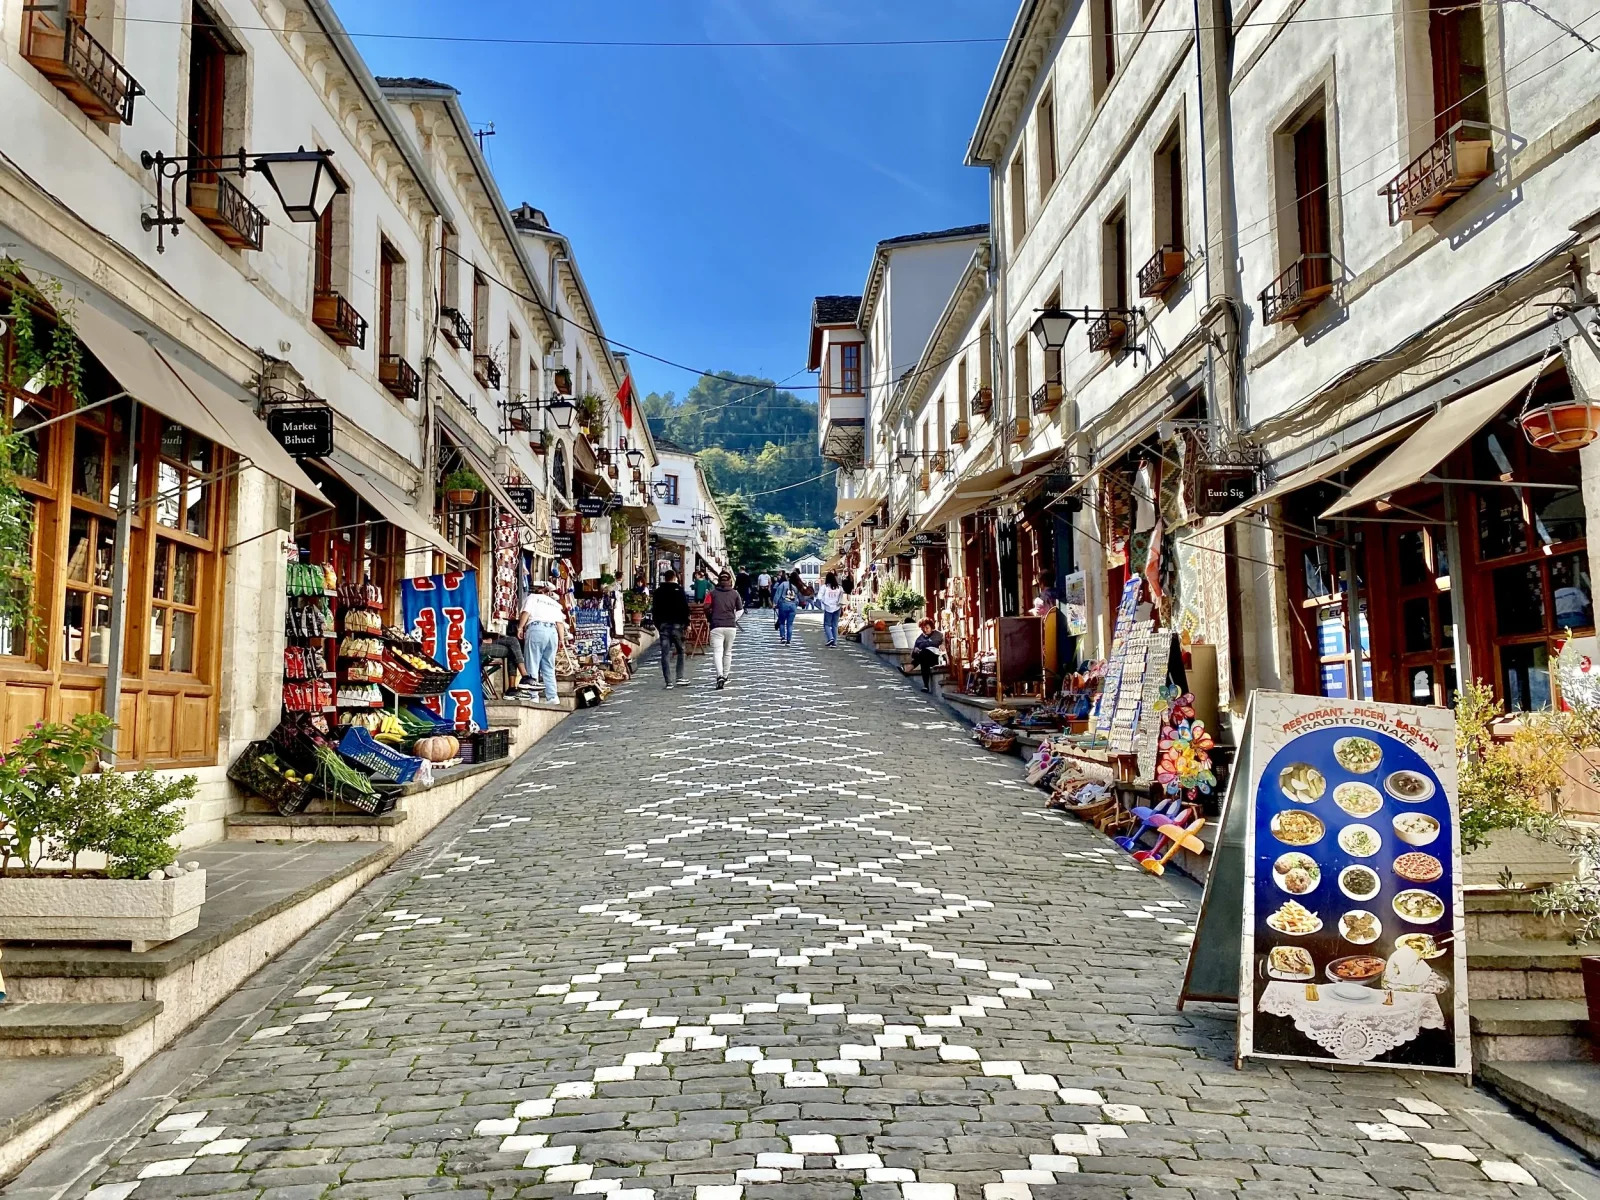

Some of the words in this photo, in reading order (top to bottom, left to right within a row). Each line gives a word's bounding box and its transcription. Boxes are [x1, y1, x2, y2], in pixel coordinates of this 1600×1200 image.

[283, 422, 317, 431] Market
[285, 435, 315, 444] Bihuci
[1207, 488, 1228, 497] Euro
[1230, 488, 1244, 499] Sig
[1282, 707, 1345, 733] RESTORANT
[1353, 707, 1387, 722] PICERI
